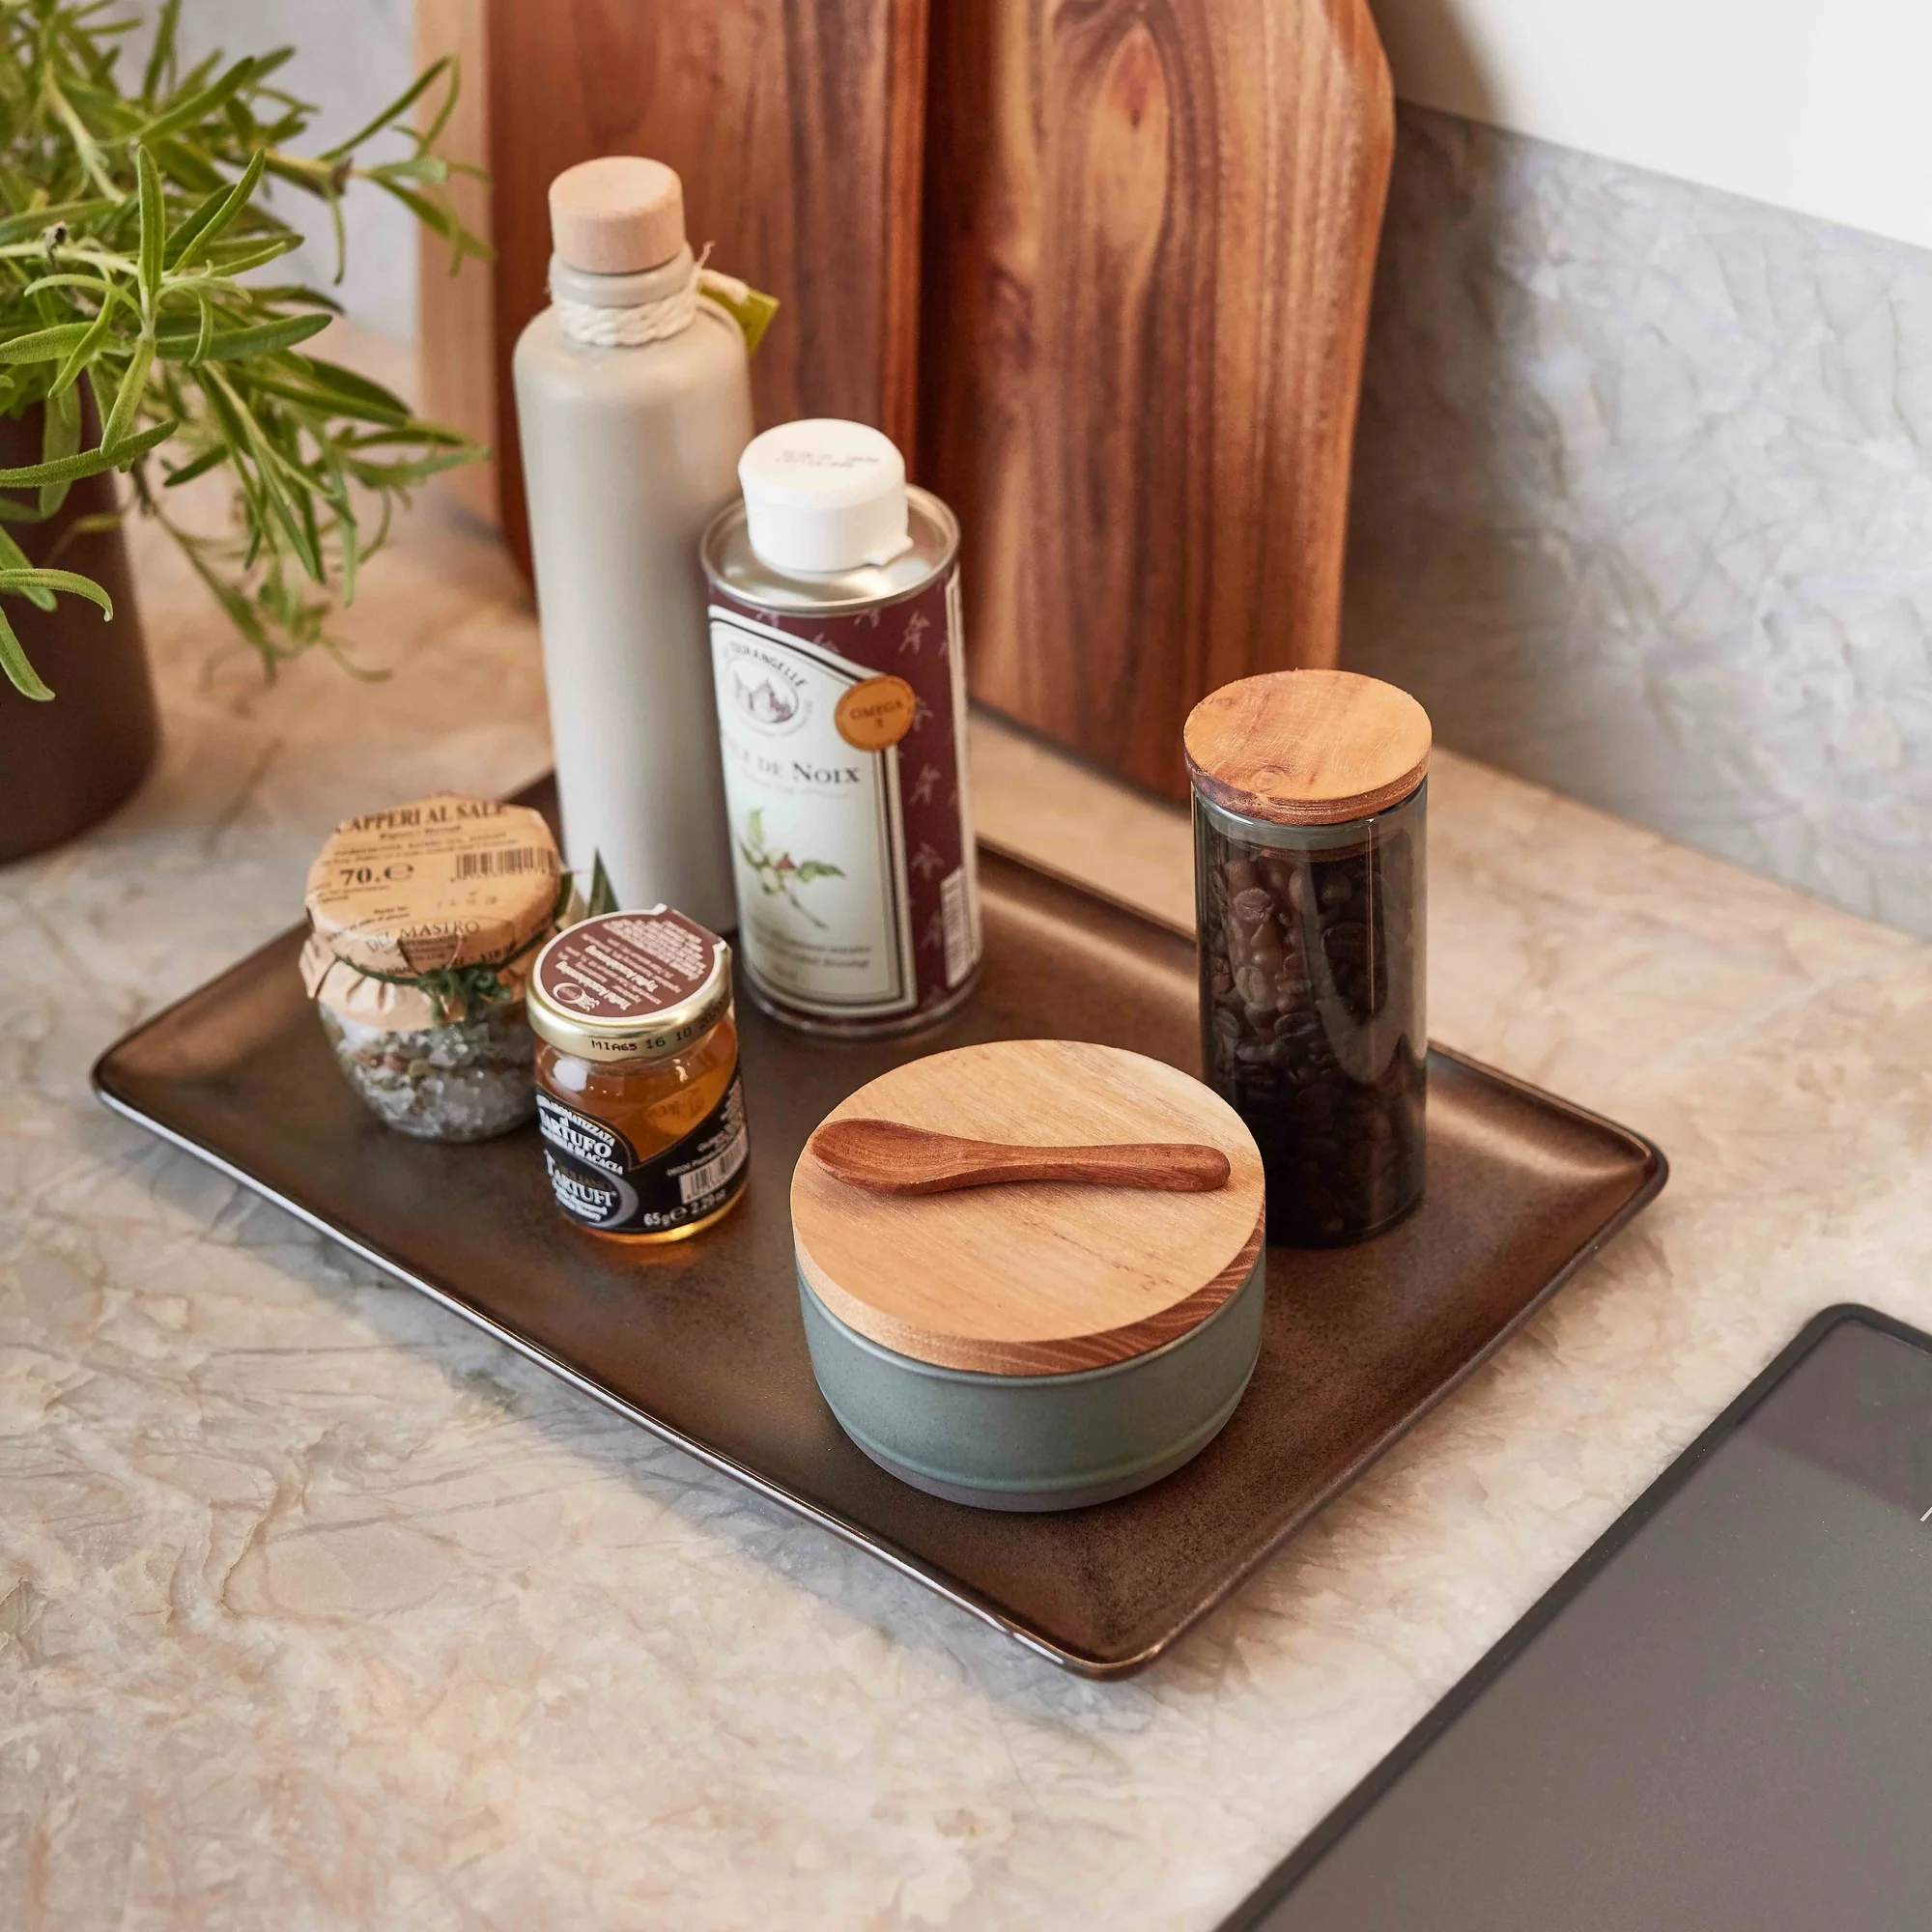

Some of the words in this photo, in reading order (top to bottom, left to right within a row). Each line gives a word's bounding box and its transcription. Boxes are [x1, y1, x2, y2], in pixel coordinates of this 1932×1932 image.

[849, 697, 904, 722] OMEGA
[349, 806, 422, 833] APPERI
[427, 803, 452, 823] AL
[456, 800, 508, 821] SALE
[590, 1038, 639, 1052] MIA65
[644, 1036, 667, 1049] 16
[676, 1025, 693, 1041] 10
[537, 1107, 612, 1158] TARTUFO
